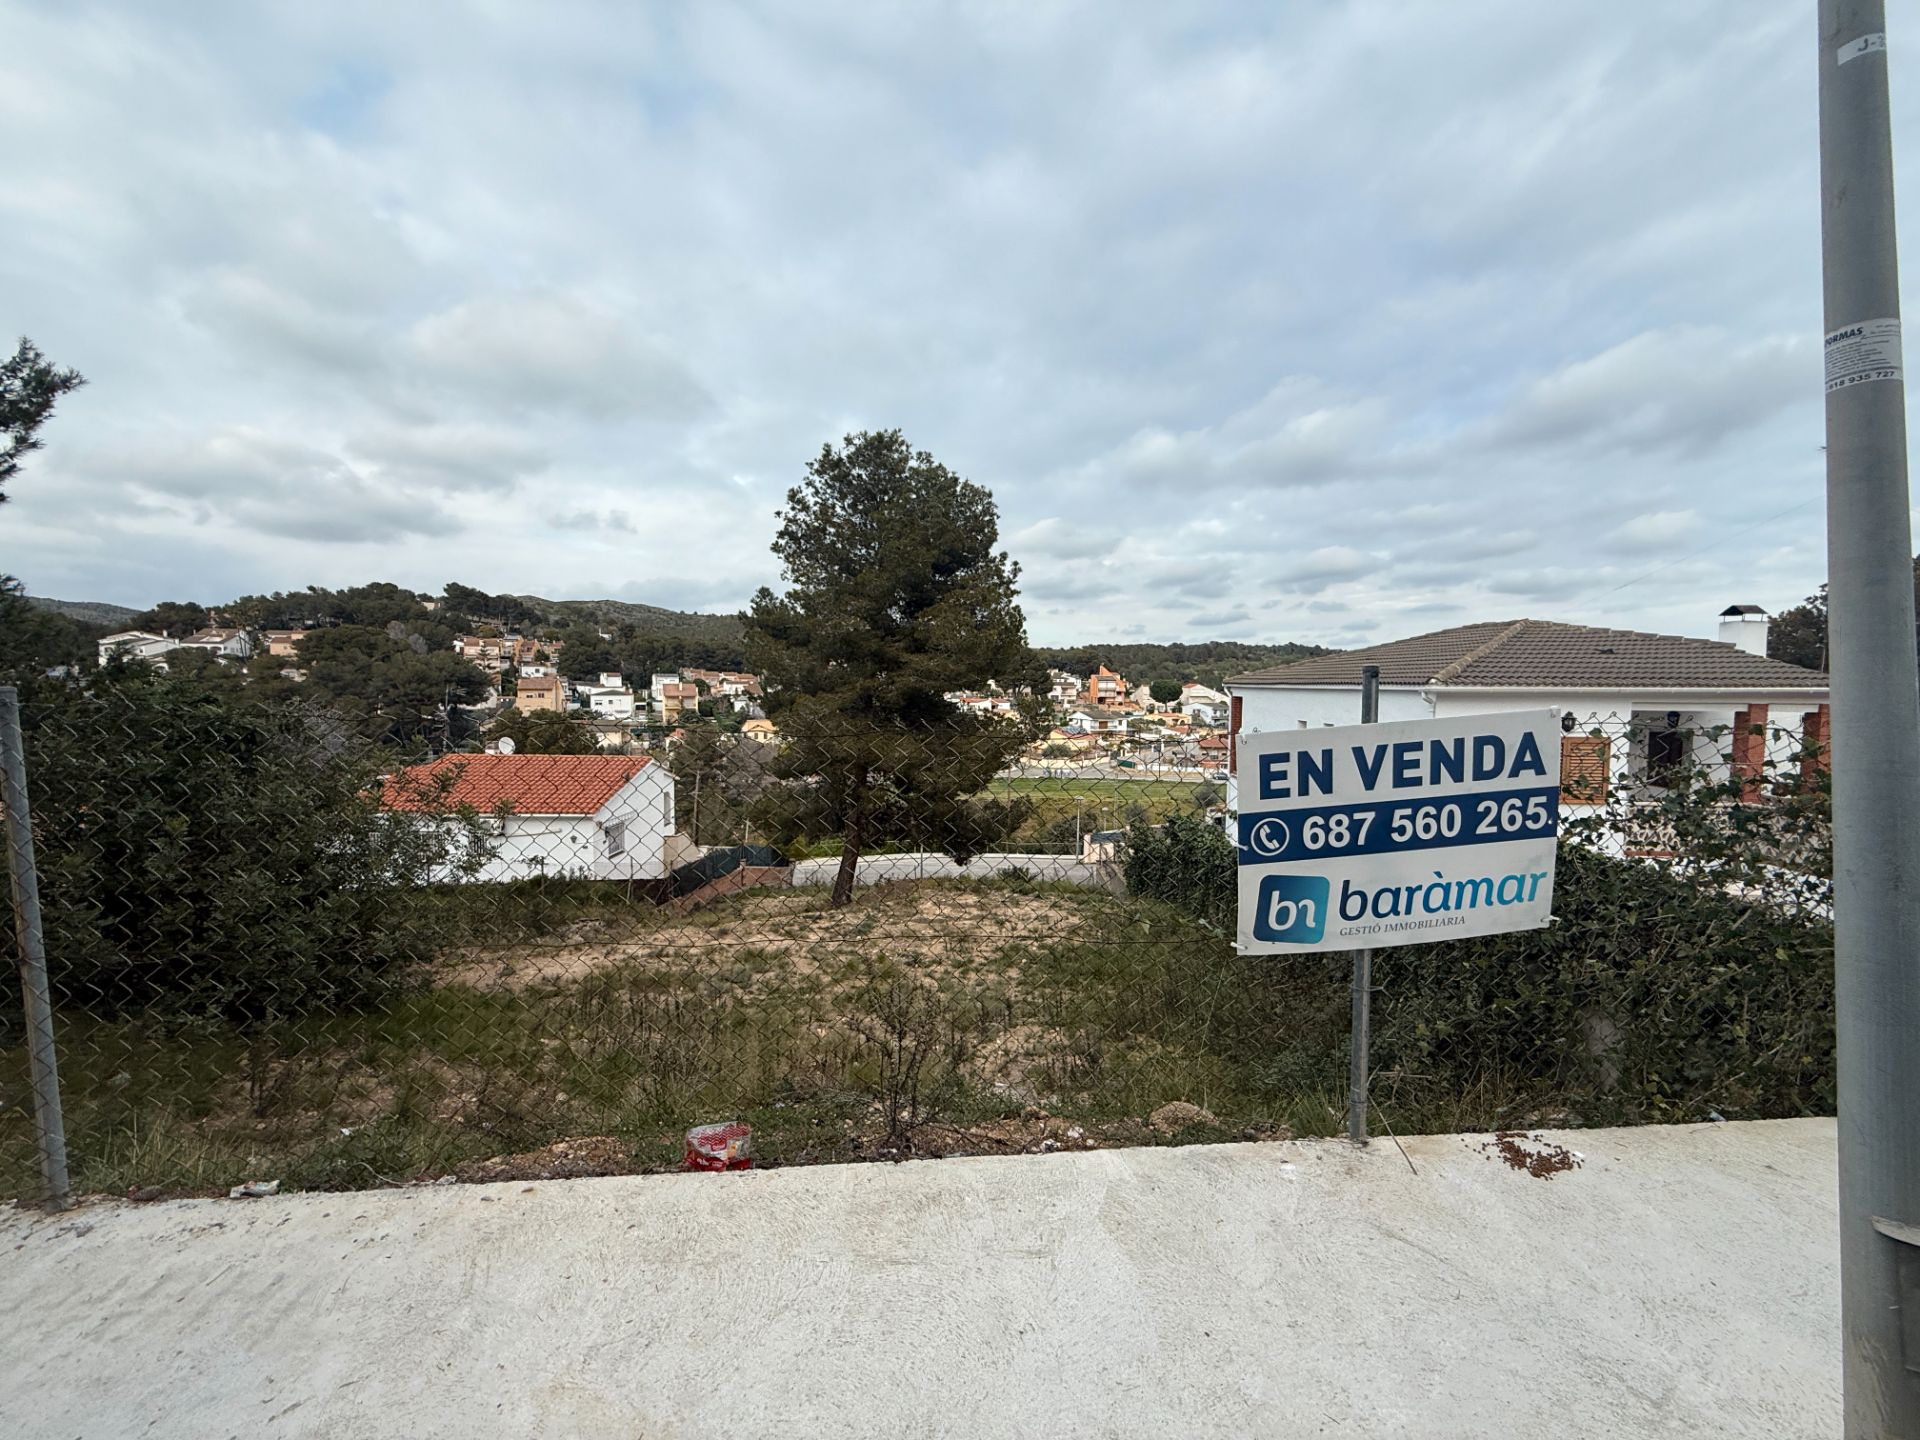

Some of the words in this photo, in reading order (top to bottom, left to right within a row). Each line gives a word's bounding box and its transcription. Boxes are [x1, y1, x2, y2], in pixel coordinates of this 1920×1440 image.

[1848, 373, 1871, 384] 935
[1258, 748, 1333, 800] EN
[1351, 731, 1547, 791] VENDA
[1302, 811, 1376, 850] 687
[1390, 803, 1462, 842] 560
[1475, 796, 1548, 835] 265
[1338, 870, 1548, 922] baràmar
[1339, 921, 1381, 937] GESTIÓ
